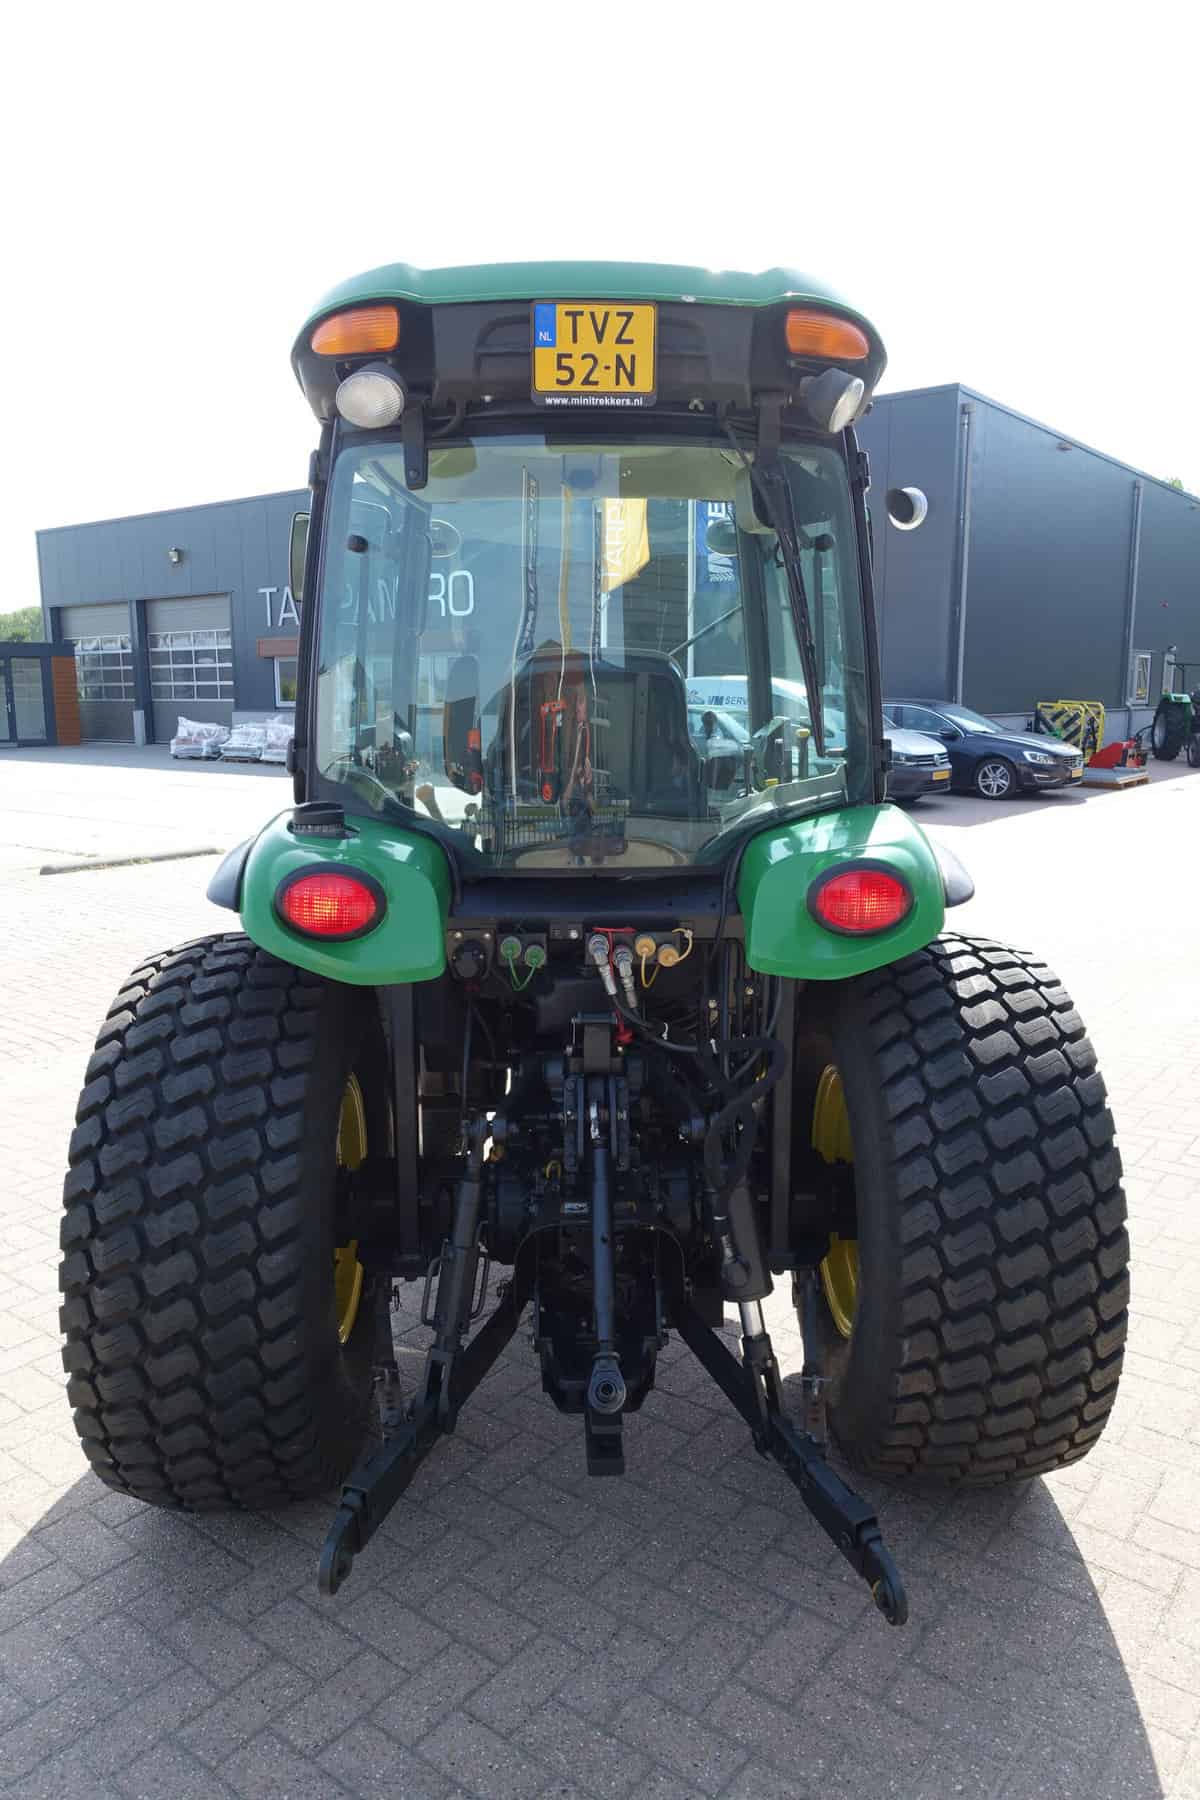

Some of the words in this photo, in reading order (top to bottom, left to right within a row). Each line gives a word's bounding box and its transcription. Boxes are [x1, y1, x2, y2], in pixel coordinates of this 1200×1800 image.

[564, 311, 635, 345] TVZ
[539, 331, 552, 342] NL
[555, 353, 636, 387] 52-N
[544, 396, 644, 407] www.minitrekkers.nl
[724, 695, 747, 706] SERV
